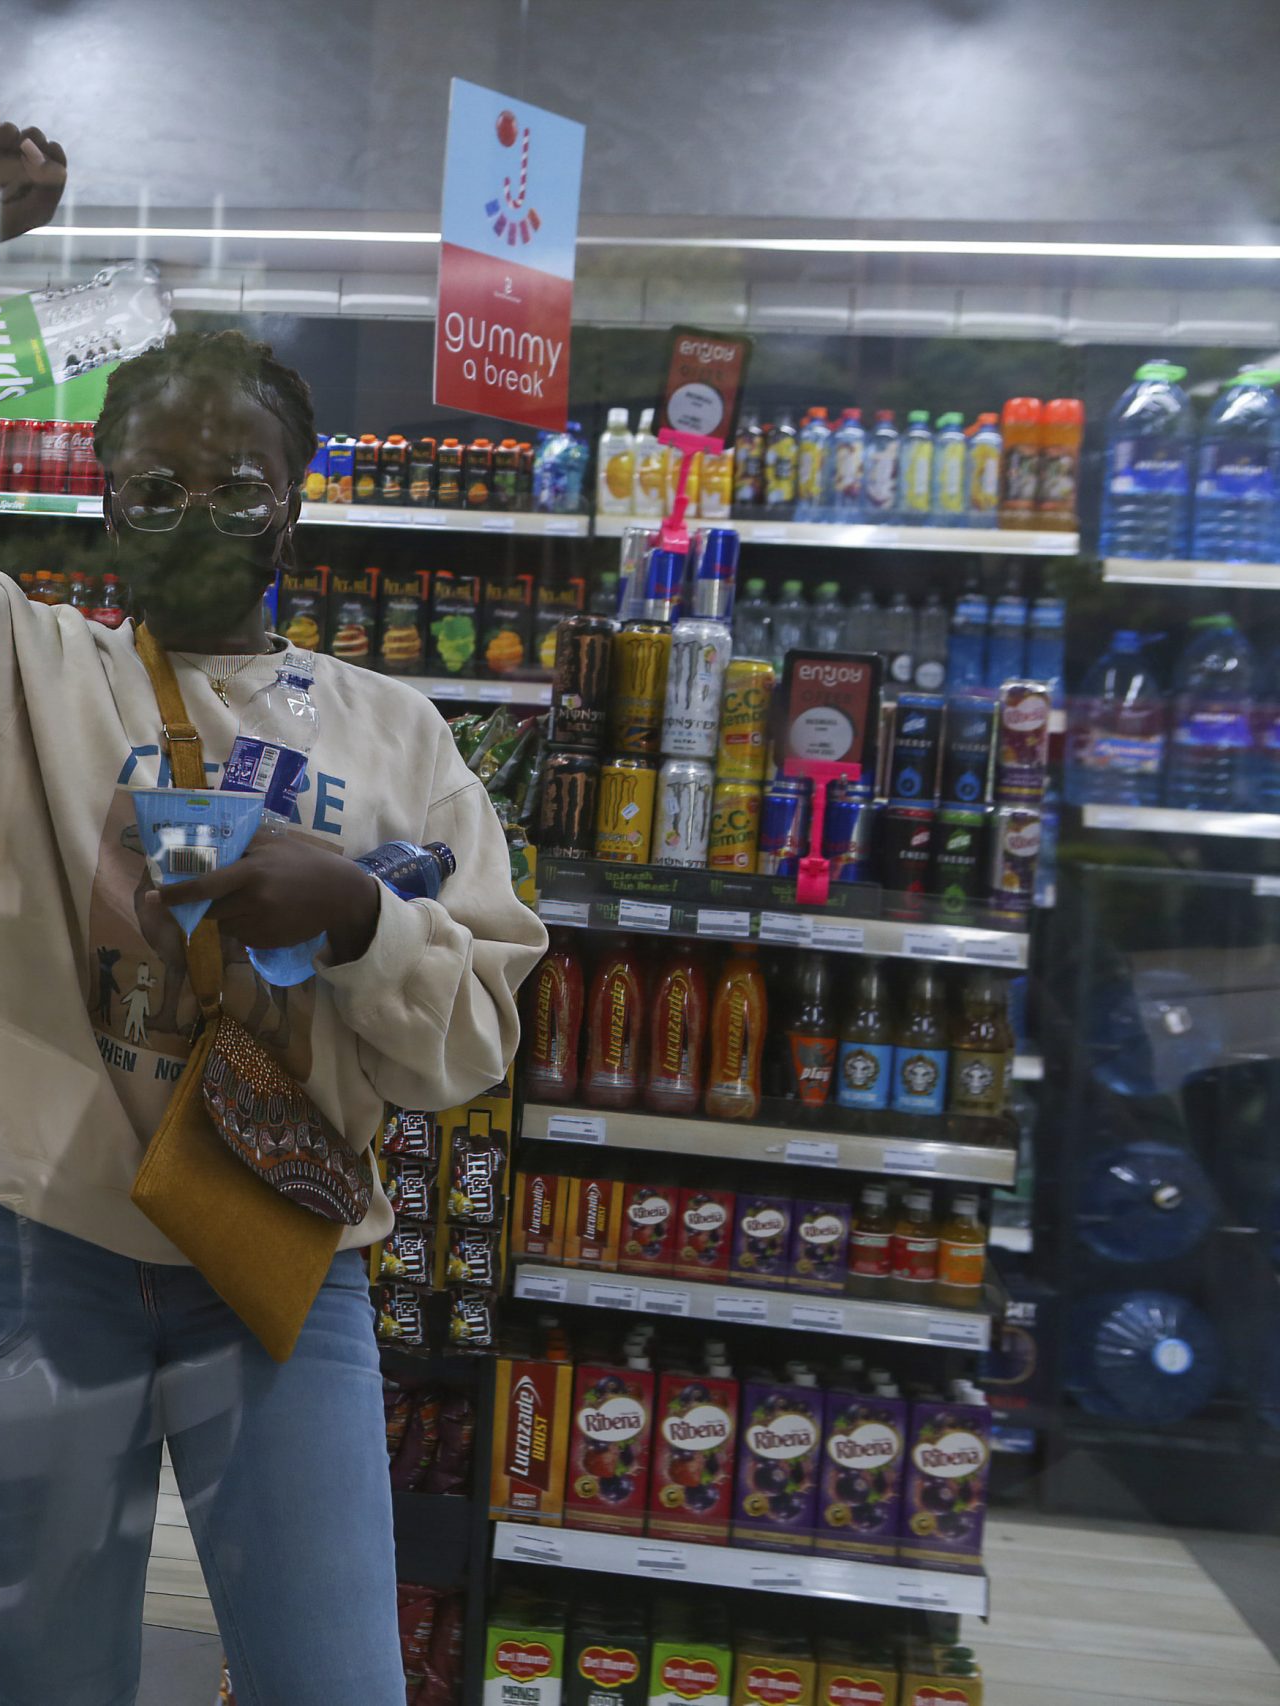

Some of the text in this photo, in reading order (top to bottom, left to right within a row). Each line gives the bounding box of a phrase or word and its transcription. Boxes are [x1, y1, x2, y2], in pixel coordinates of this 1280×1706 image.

[444, 312, 563, 378] gummy
[463, 356, 544, 398] a break
[799, 665, 863, 687] enjoy
[94, 1030, 187, 1082] HEN NO
[528, 1184, 546, 1234] Lucozade
[583, 1190, 601, 1240] Lucozade
[584, 1412, 641, 1433] Ribena
[669, 1421, 726, 1442] Ribena
[509, 1390, 535, 1477] Lucozade
[532, 1416, 549, 1462] BOOST
[753, 1429, 812, 1450] Ribena
[835, 1438, 894, 1459] Ribena
[921, 1448, 980, 1469] Ribena
[497, 1650, 550, 1666] Del Monte
[583, 1656, 636, 1673] Del Monte
[663, 1666, 717, 1683] Del Monte
